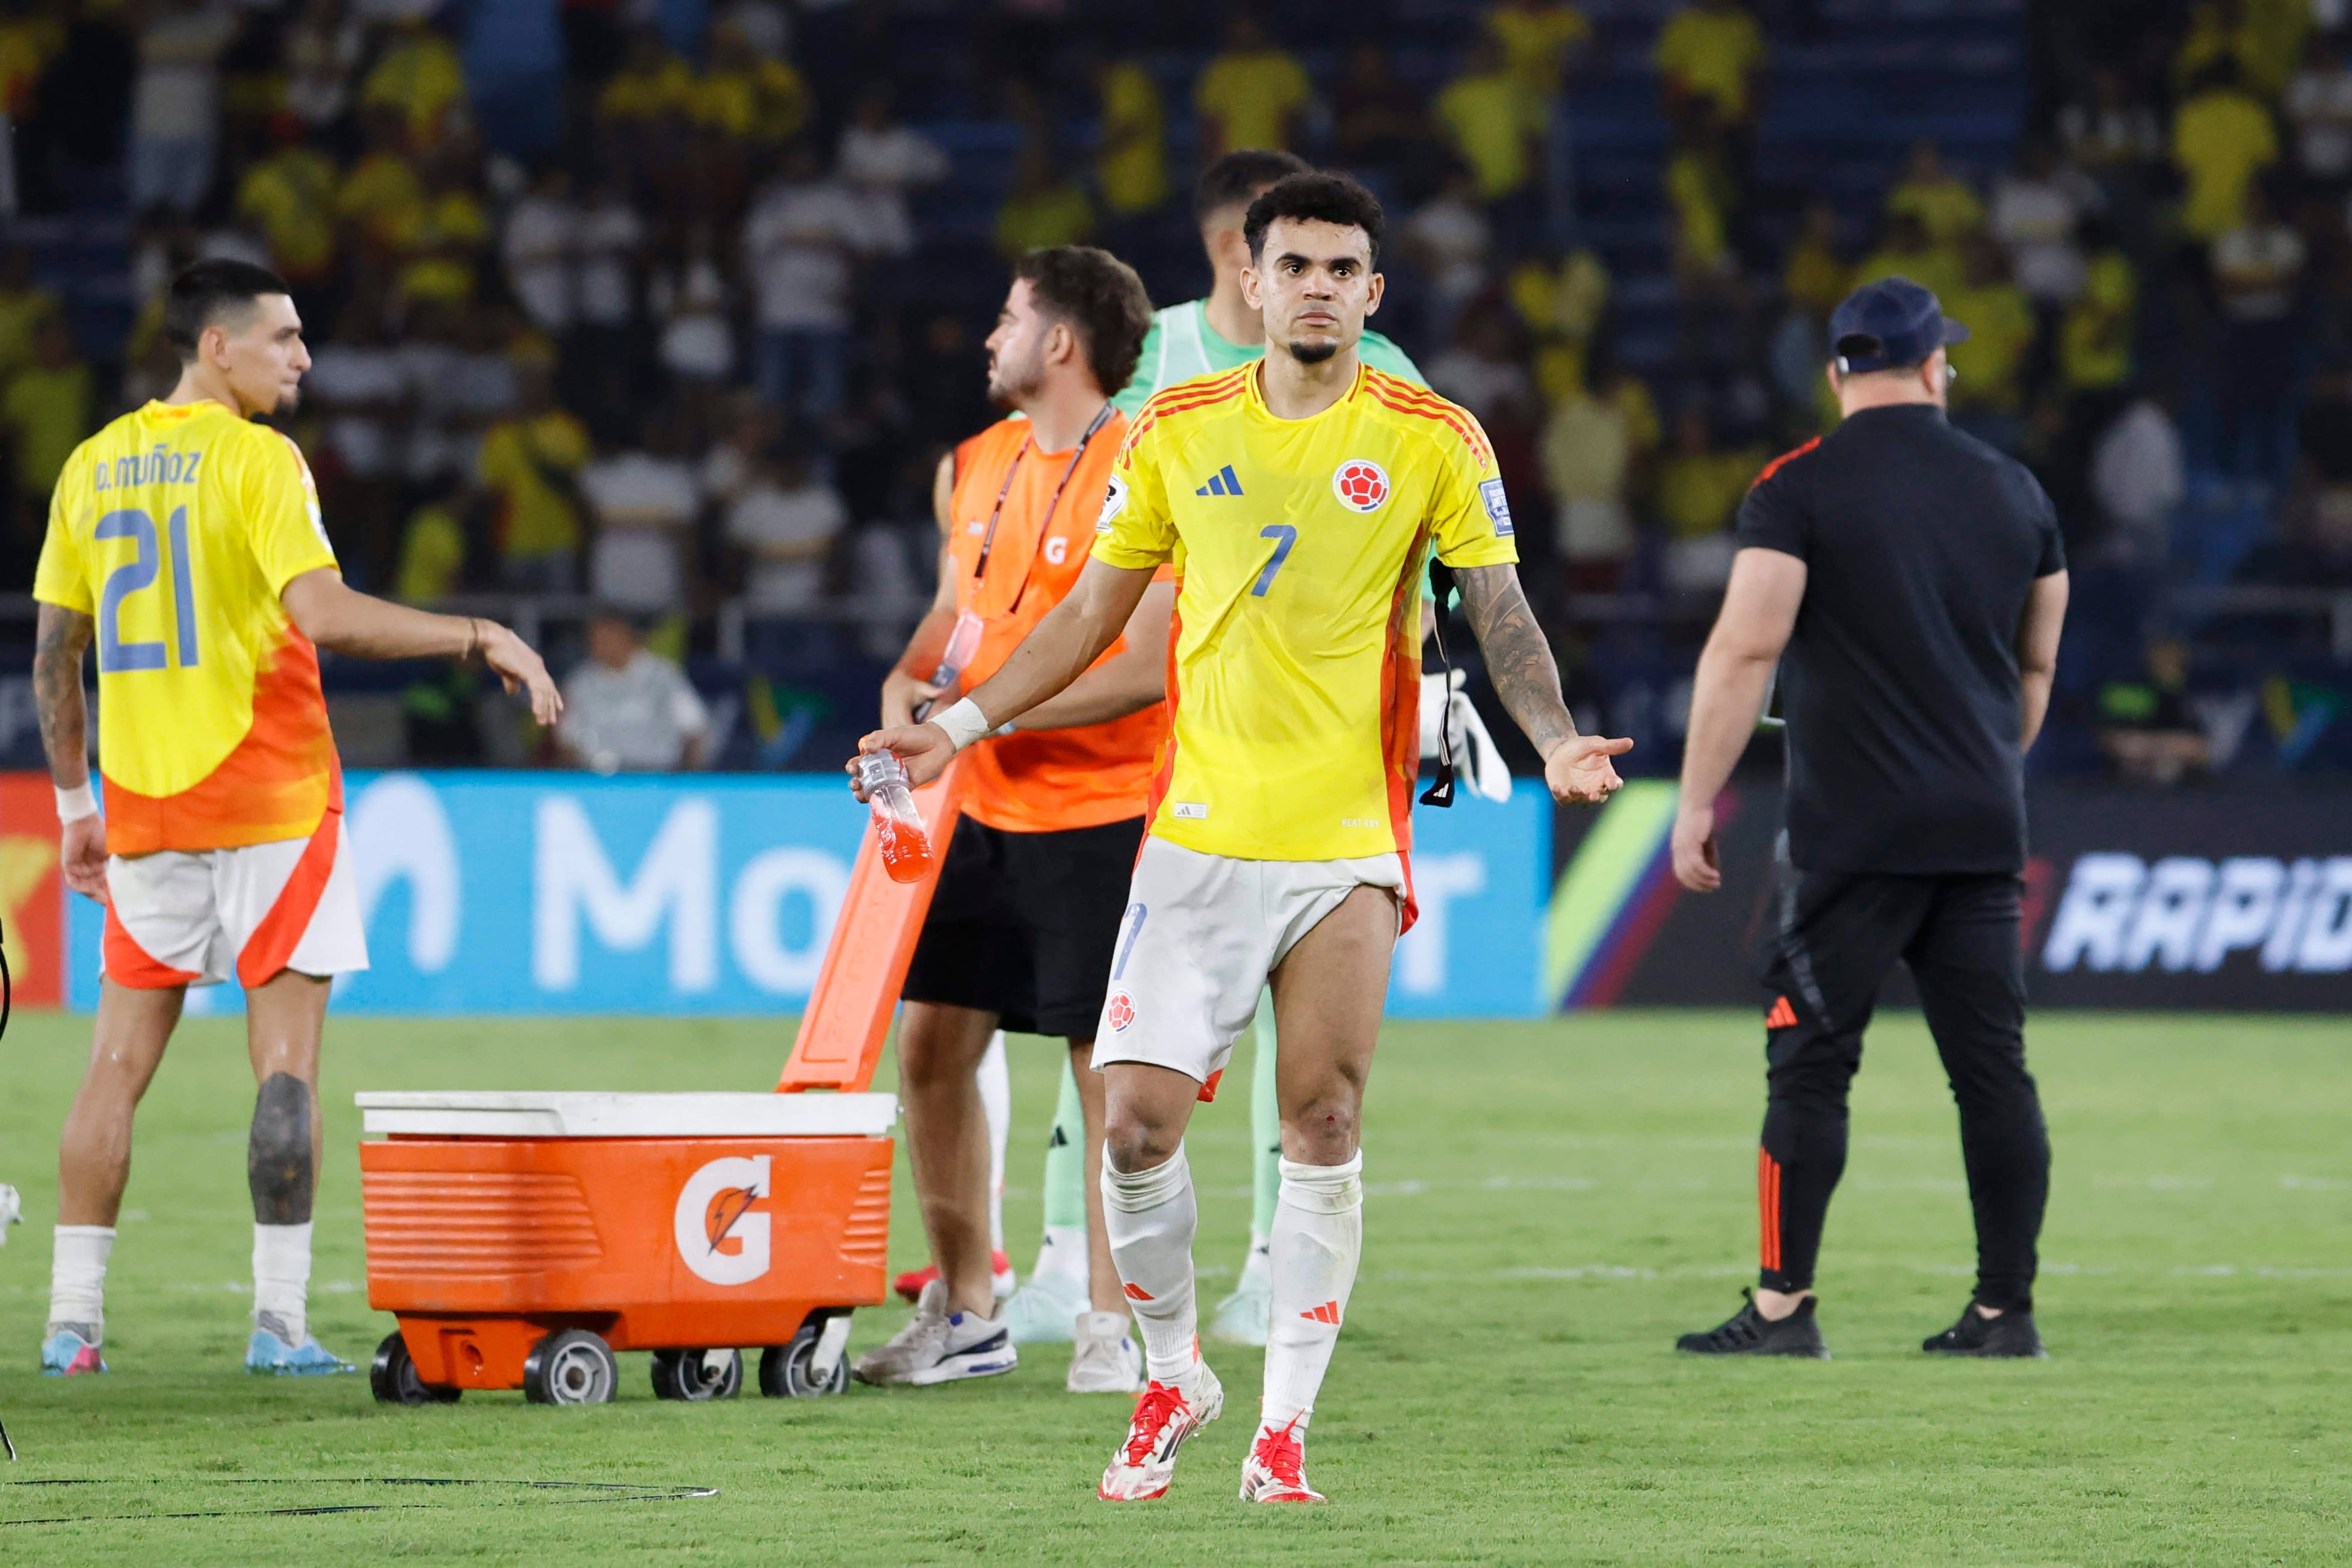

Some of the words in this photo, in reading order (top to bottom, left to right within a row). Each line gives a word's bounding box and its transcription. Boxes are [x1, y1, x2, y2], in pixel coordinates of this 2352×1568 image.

[116, 444, 201, 487] MUÑOZ
[1046, 537, 1068, 564] G
[1251, 525, 1297, 596] 7
[94, 504, 198, 673] 21
[1114, 903, 1147, 981] 7
[674, 1155, 771, 1285] G
